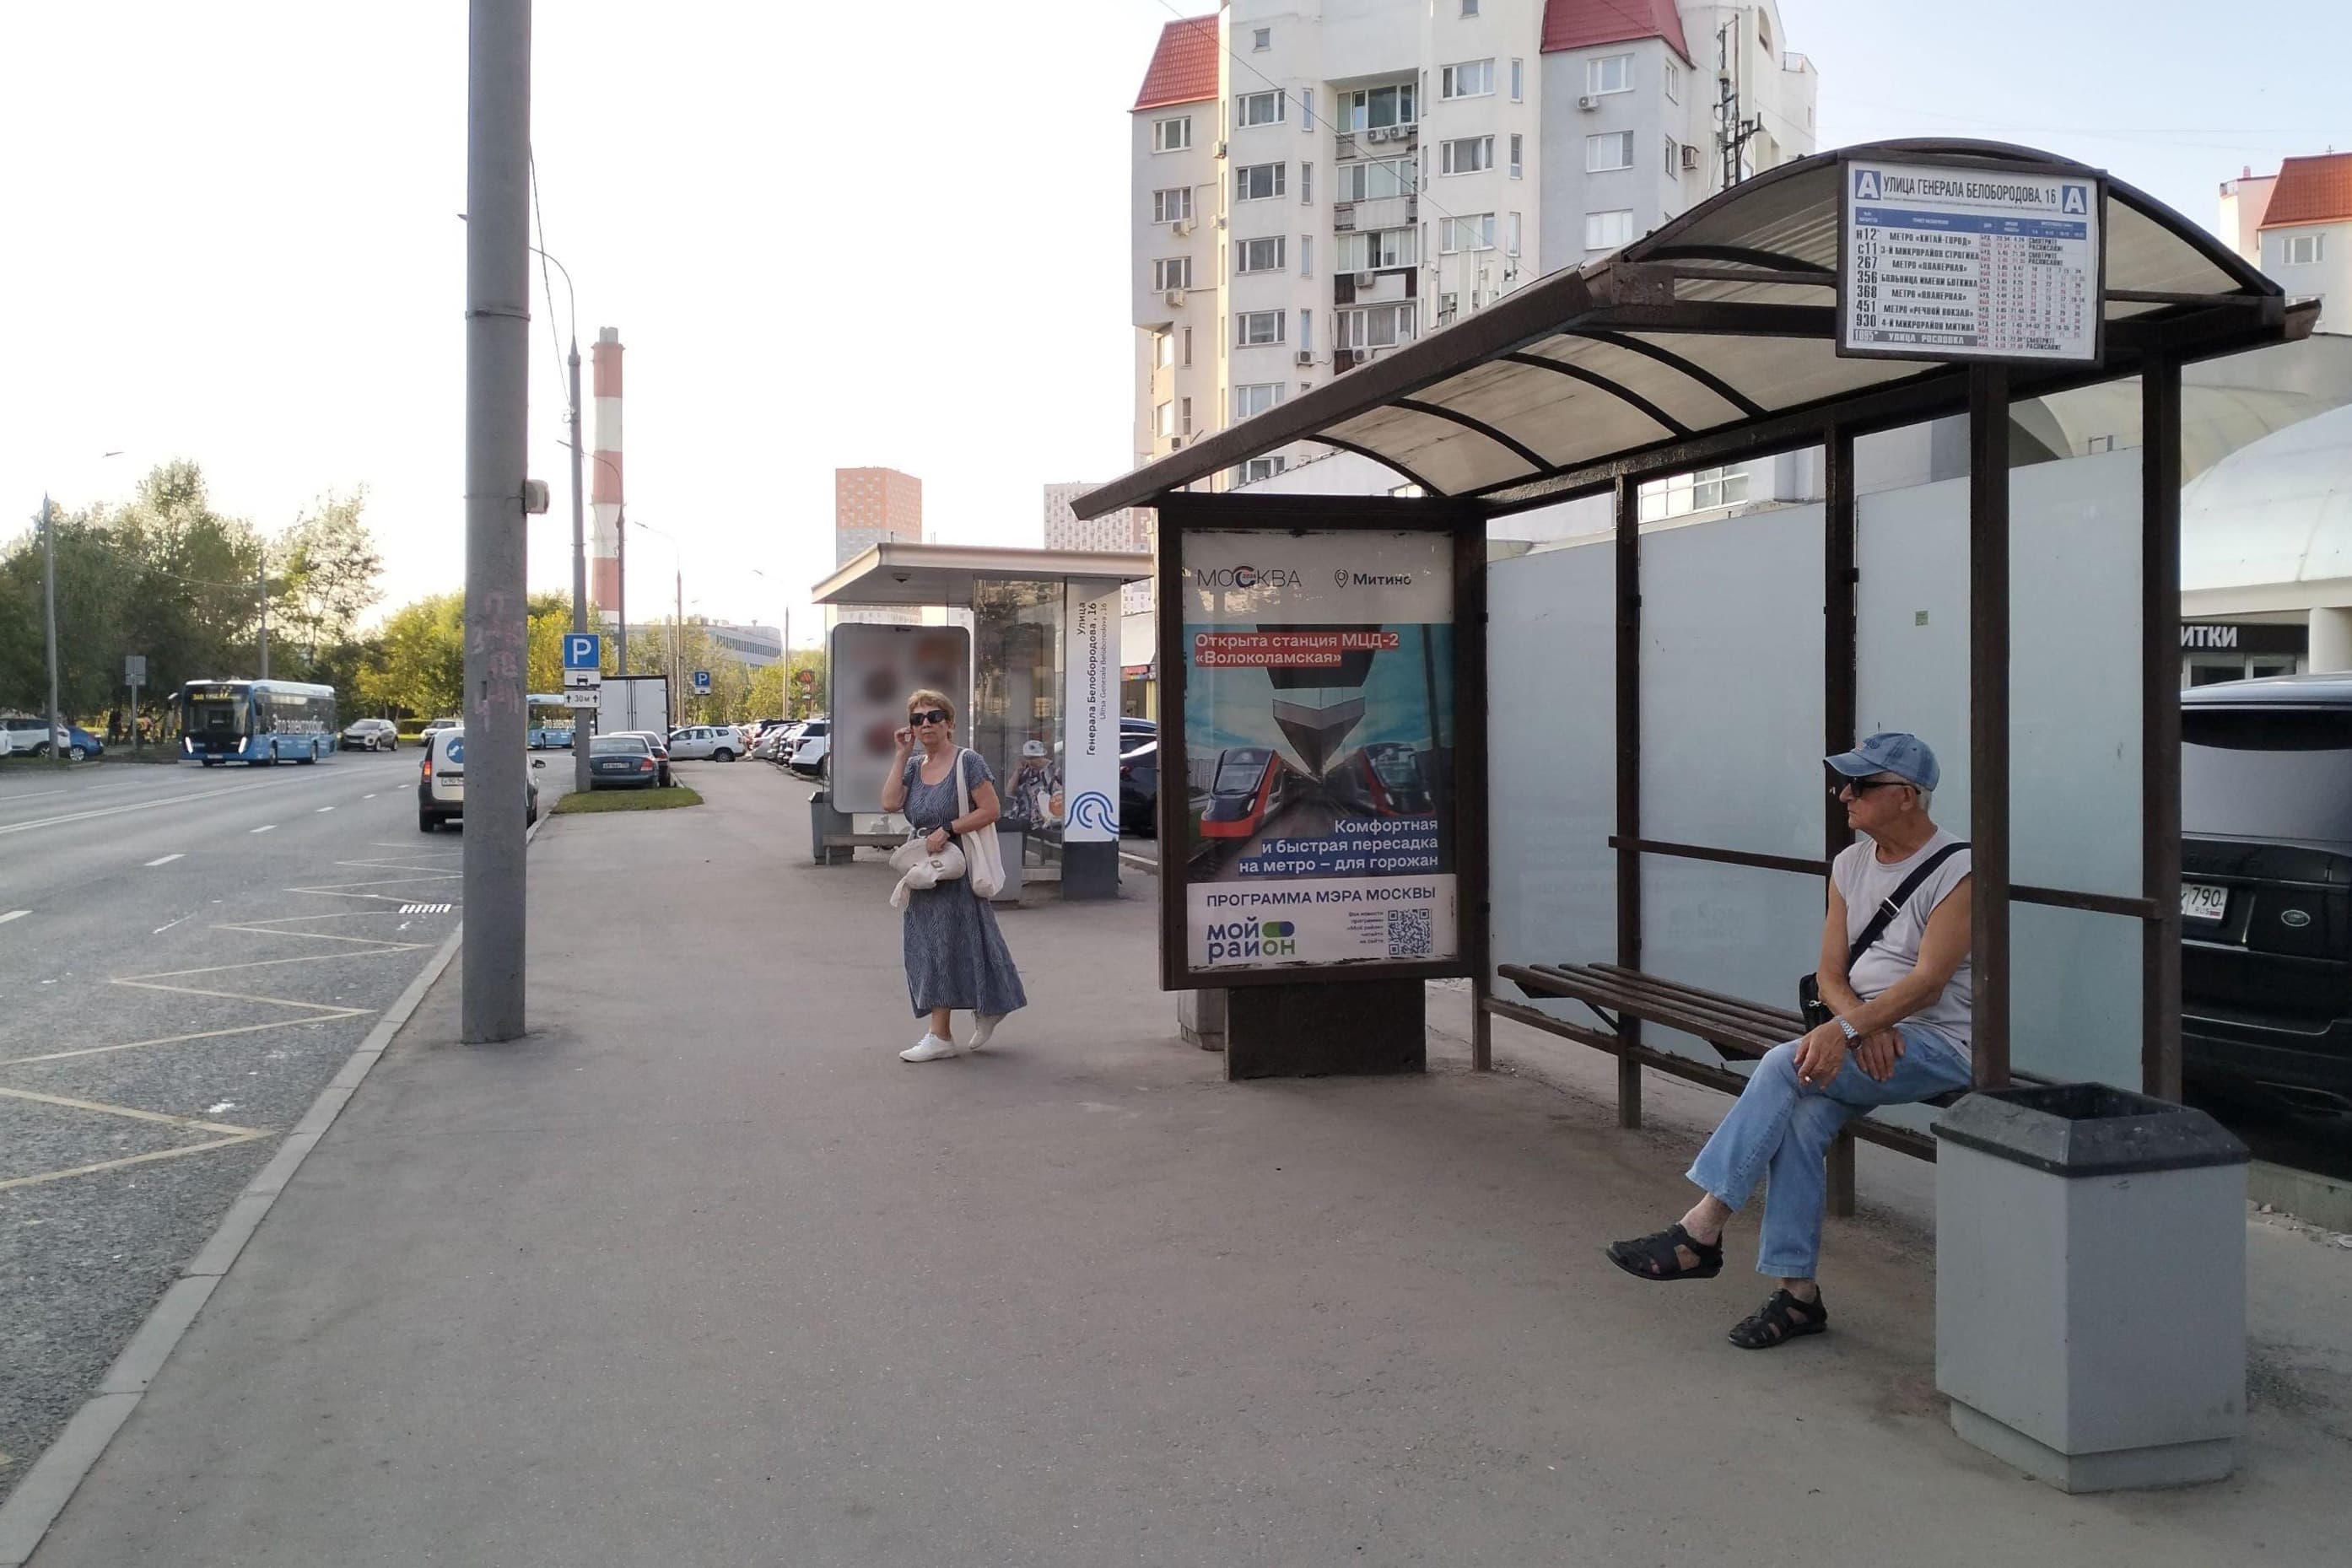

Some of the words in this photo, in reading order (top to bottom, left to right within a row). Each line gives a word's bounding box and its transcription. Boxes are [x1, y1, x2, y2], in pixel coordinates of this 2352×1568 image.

[1883, 175, 1915, 195] УЛИЦА
[1918, 179, 1964, 198] ГЕНЕРАЛА
[1966, 182, 2042, 204] БЕЛОБОРОДОВА,
[2045, 188, 2057, 203] 16
[1889, 232, 1913, 241] МЕТРО
[1858, 256, 1878, 269] 267
[1892, 260, 1917, 269] МЕТРО
[1857, 270, 1878, 284] 356
[1881, 273, 1918, 285] БОЛЬНИЦА
[1857, 284, 1877, 299] 368
[1891, 288, 1916, 298] МЕТРО
[1856, 299, 1875, 313] 451
[1884, 304, 1907, 314] МЕТРО
[1856, 313, 1877, 327] 930
[1197, 565, 1302, 588] МОСКВА
[1087, 603, 1097, 615] 16
[1076, 602, 1086, 635] Улица
[1195, 633, 1267, 649] Открыта
[1272, 635, 1337, 649] станция
[1342, 633, 1399, 649] МЦД-2
[573, 639, 591, 665] P
[1195, 651, 1342, 665] «Волоколамская»
[1087, 707, 1097, 756] Генерала
[1335, 818, 1438, 834] Комфортная
[1262, 844, 1271, 854] и
[1276, 839, 1348, 855] быстрая
[1352, 838, 1438, 852] пересадка
[1239, 861, 1259, 873] на
[1264, 859, 1316, 874] метро
[1335, 859, 1365, 871] для
[1370, 855, 1438, 870] горожан
[1207, 892, 1313, 908] ПРОГРАММА
[1316, 890, 1362, 903] МЭРА
[1366, 886, 1436, 901] МОСКВЫ
[2192, 887, 2221, 908] 790
[1206, 916, 1260, 940] мой
